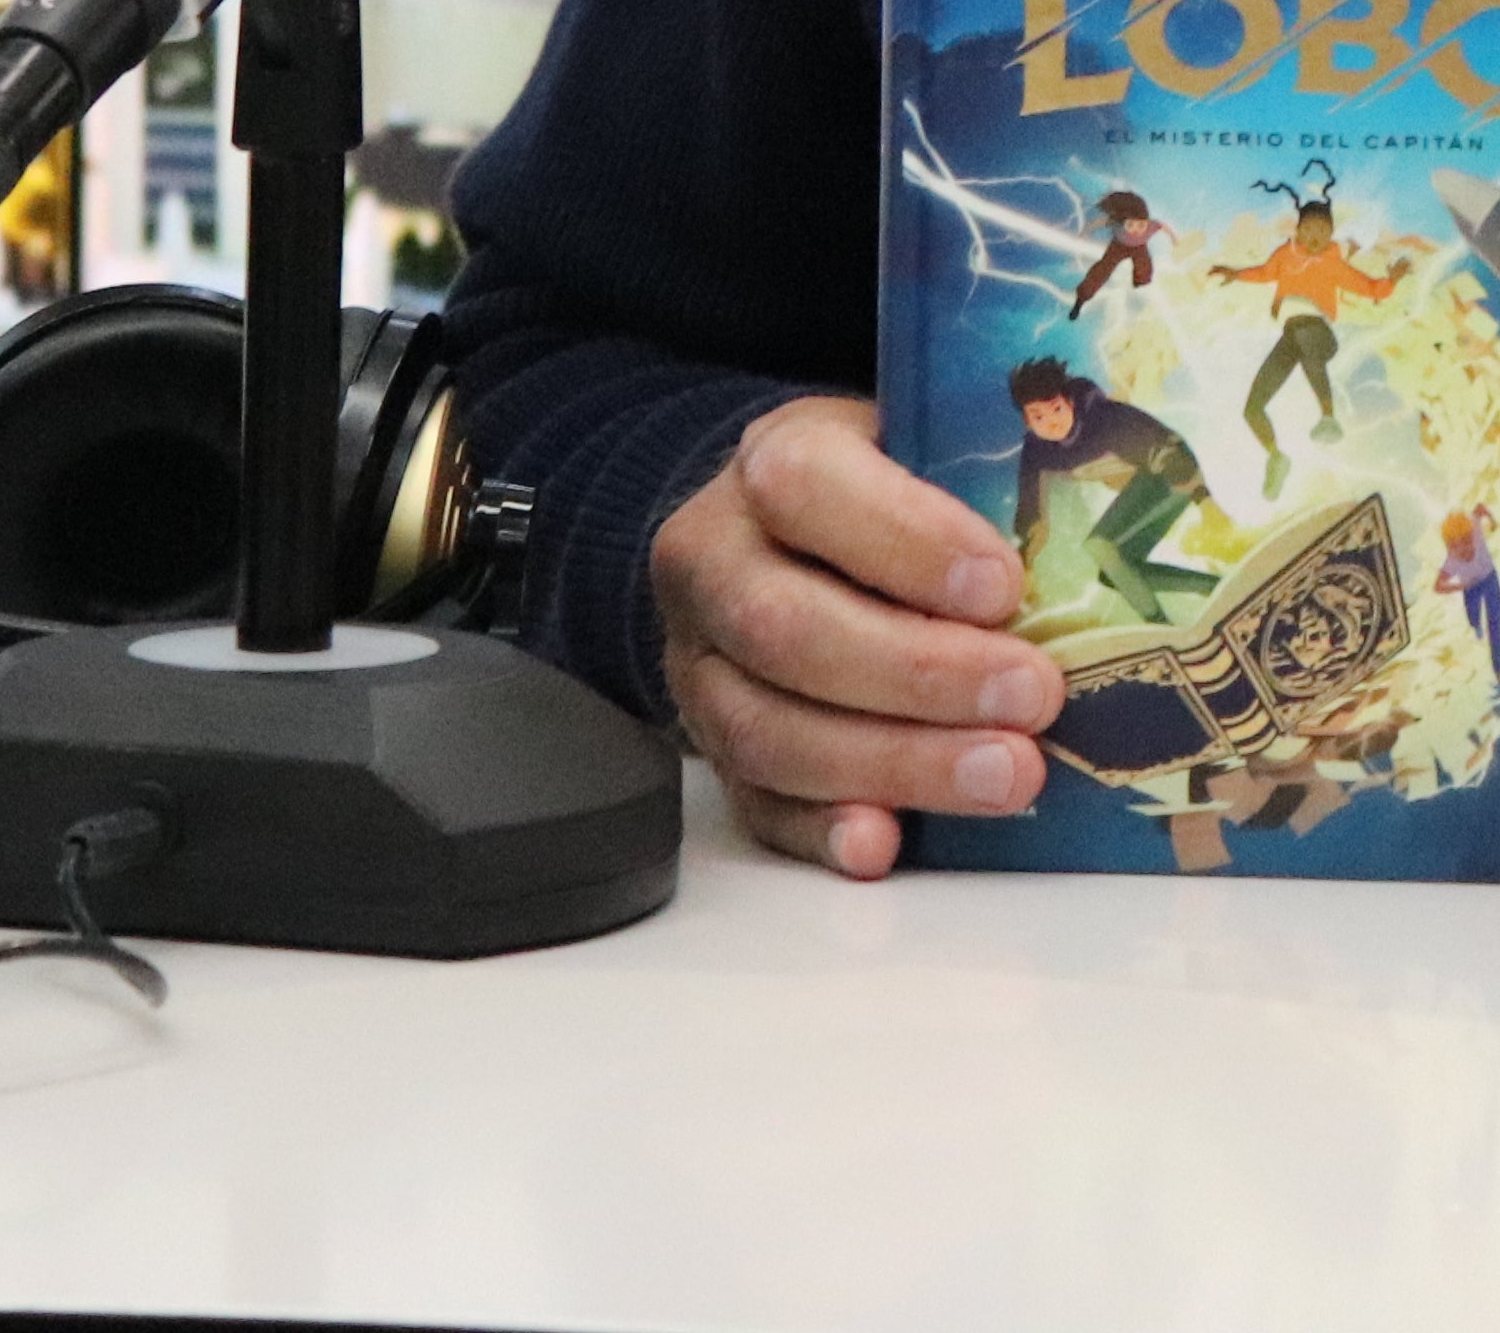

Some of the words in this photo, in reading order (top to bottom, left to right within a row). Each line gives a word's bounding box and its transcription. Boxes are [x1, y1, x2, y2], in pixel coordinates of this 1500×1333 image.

[1105, 131, 1134, 145] EL
[1149, 131, 1284, 148] MISTERIO
[1301, 133, 1349, 149] DEL
[1364, 132, 1483, 152] CAPITÁN
